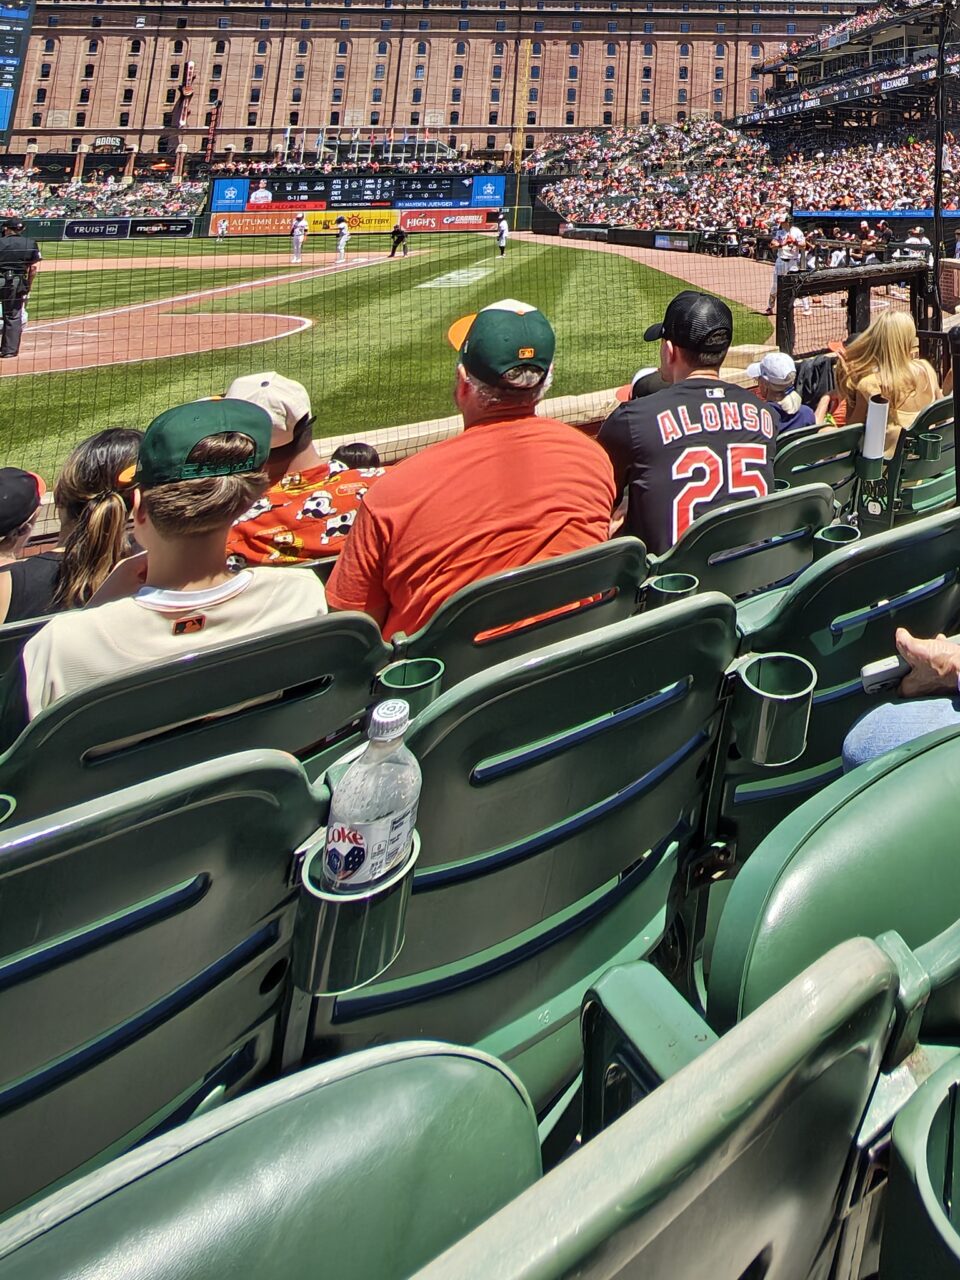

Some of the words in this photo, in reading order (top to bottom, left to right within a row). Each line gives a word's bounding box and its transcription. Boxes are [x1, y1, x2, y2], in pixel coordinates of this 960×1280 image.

[881, 76, 909, 91] ALEXANDER
[231, 218, 272, 226] AUTUMN
[406, 217, 436, 228] HIGH'S
[74, 226, 105, 234] TRUIST
[657, 401, 774, 445] ALONSO
[672, 443, 768, 547] 25
